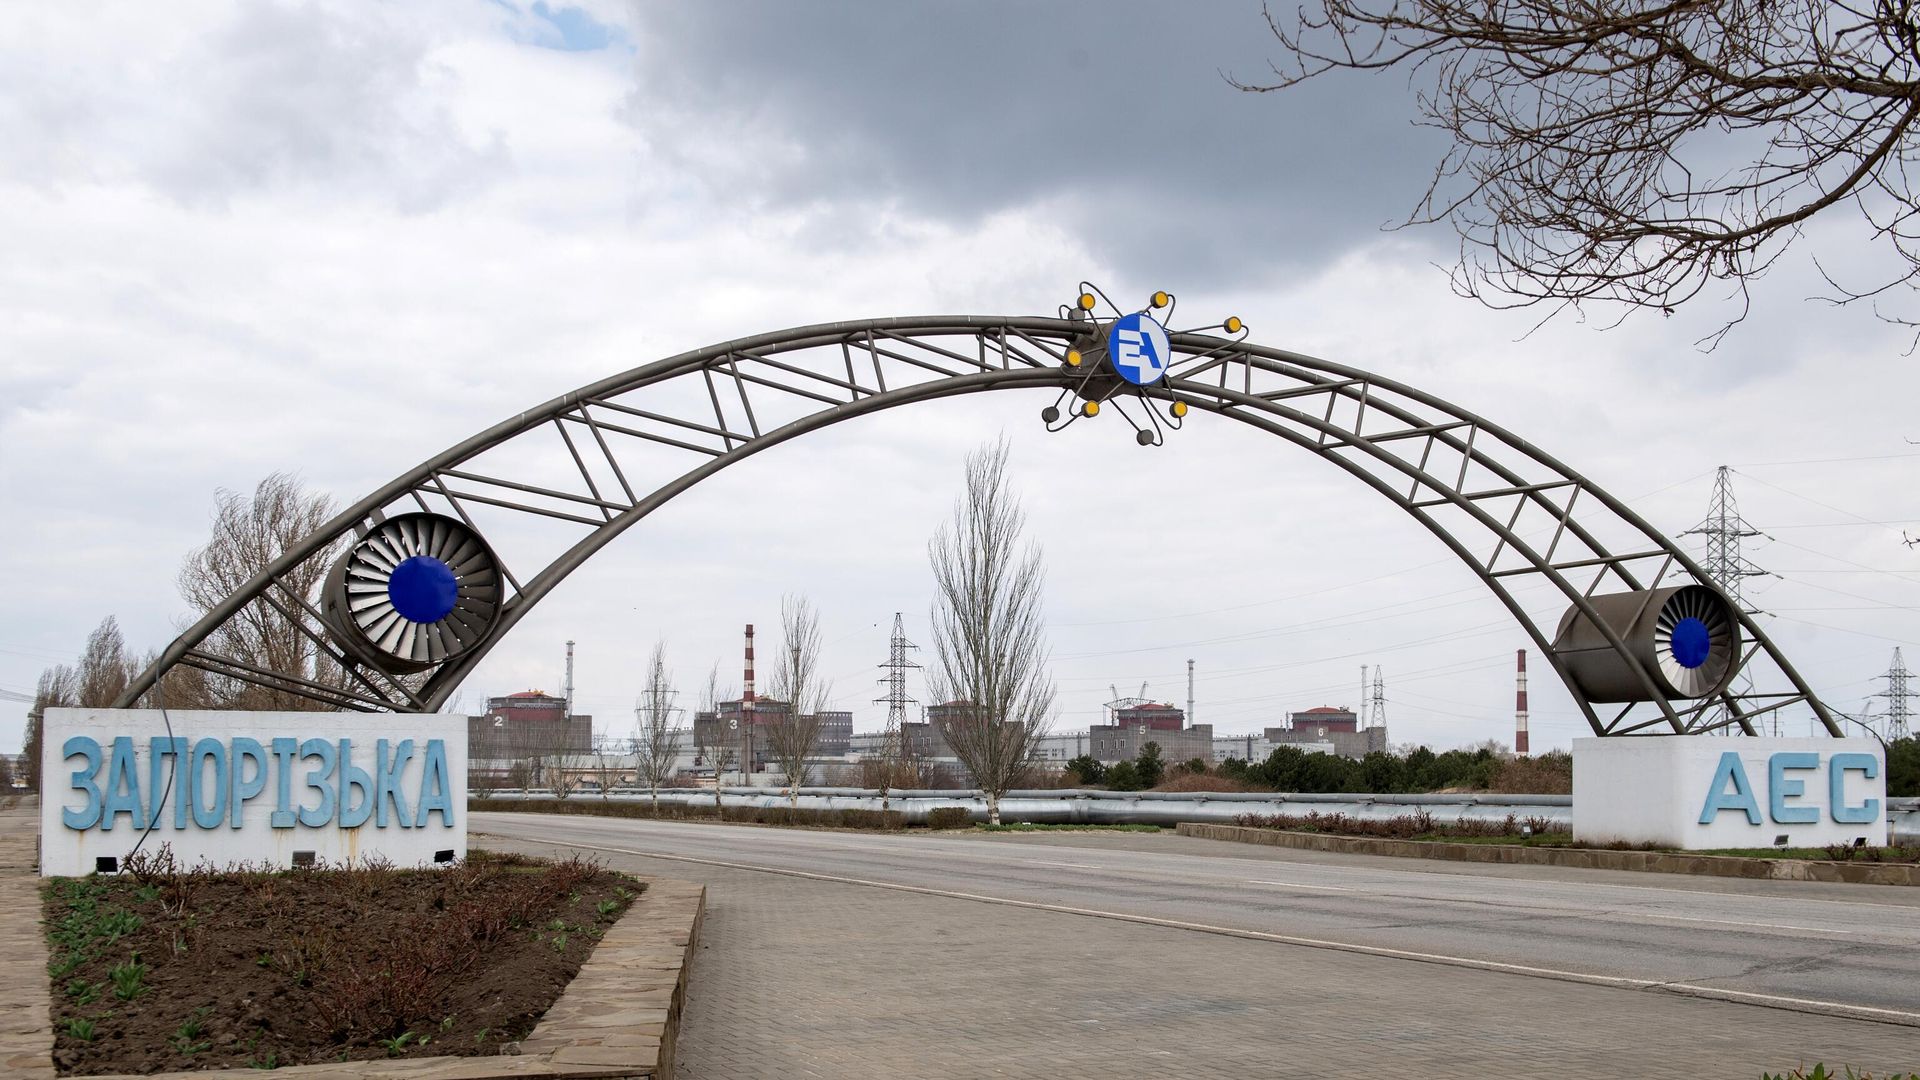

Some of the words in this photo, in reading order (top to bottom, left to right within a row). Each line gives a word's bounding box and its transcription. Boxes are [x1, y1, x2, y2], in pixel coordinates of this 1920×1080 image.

[494, 716, 503, 726] 2
[730, 719, 738, 729] 3
[1139, 725, 1145, 734] 5
[1318, 727, 1324, 736] 6
[63, 736, 454, 830] ЗАПОРІЗЬКА
[1698, 752, 1879, 825] АЕС
